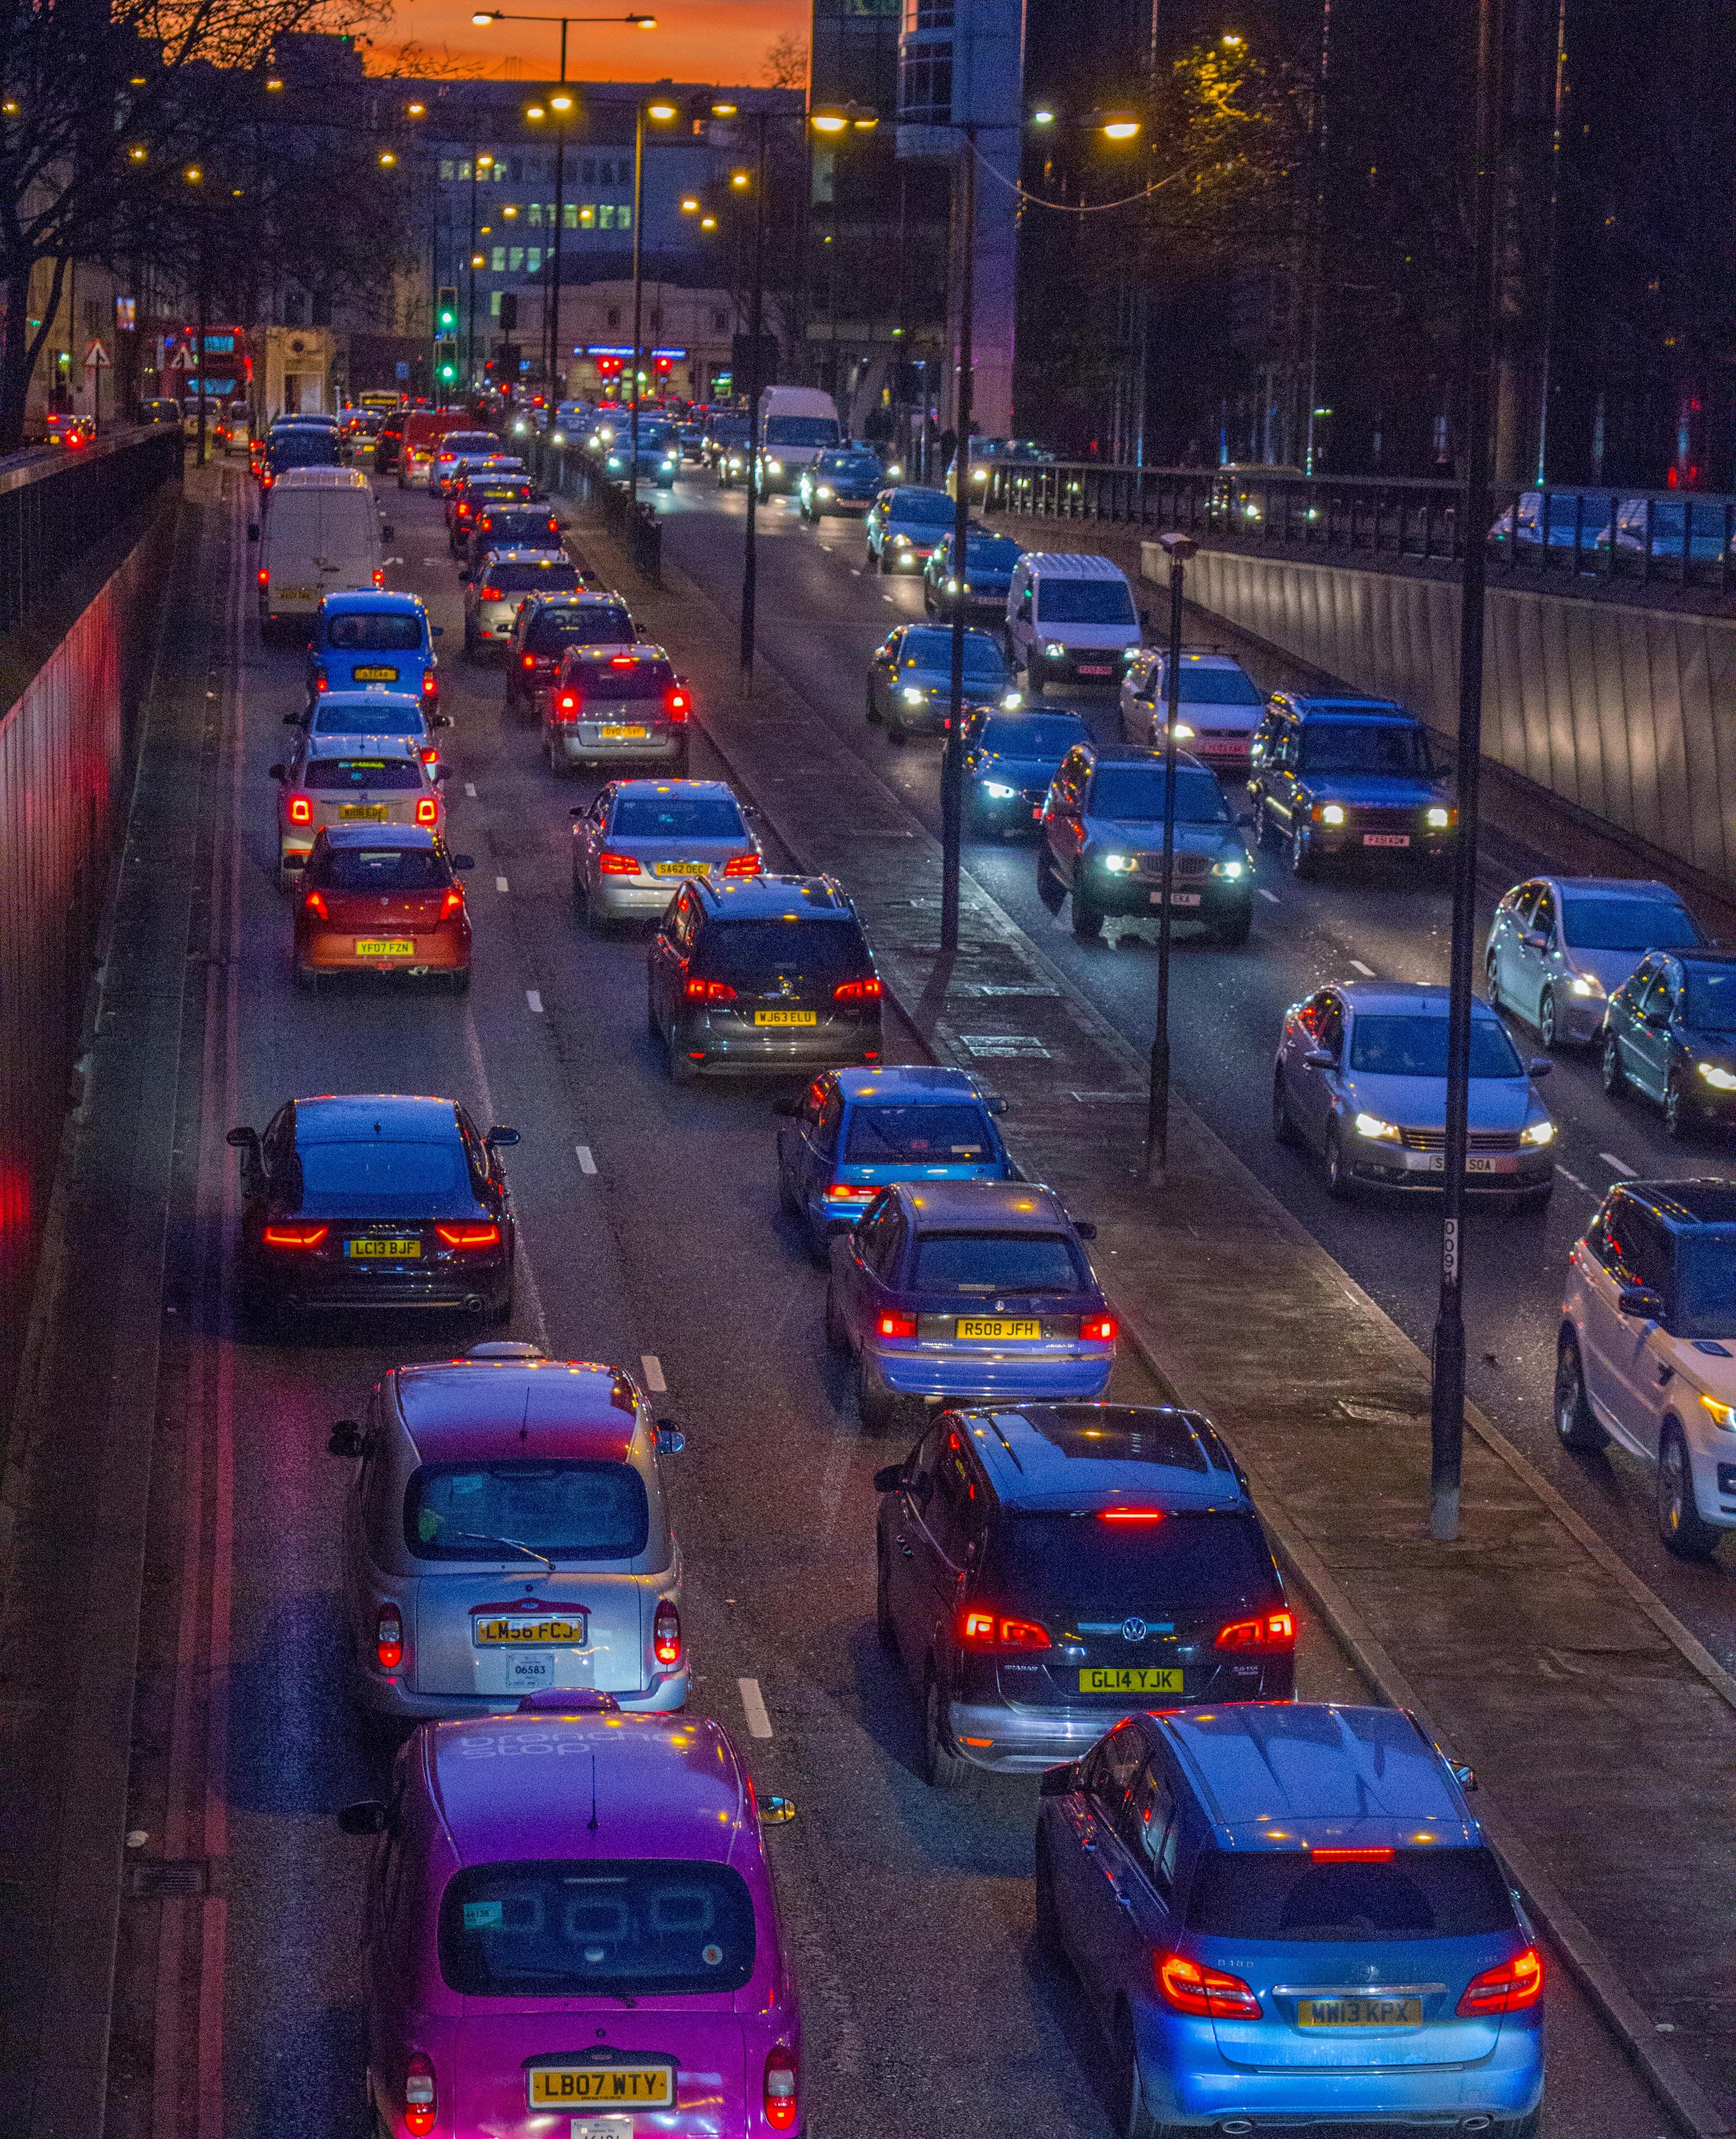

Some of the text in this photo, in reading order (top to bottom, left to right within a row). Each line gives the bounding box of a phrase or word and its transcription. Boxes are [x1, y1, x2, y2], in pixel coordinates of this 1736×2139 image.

[361, 943, 409, 953] YF07 FZN
[759, 1012, 811, 1023] WJ63 ELU
[356, 1241, 415, 1255] LC13 BJF
[964, 1322, 1033, 1336] R508 JFH
[485, 1622, 573, 1640] LM56 FCJ
[515, 1665, 546, 1674] 06583
[1092, 1671, 1172, 1688] GL14 YJK
[1365, 2001, 1409, 2022] KPX
[545, 2073, 657, 2097] LB07 WTY
